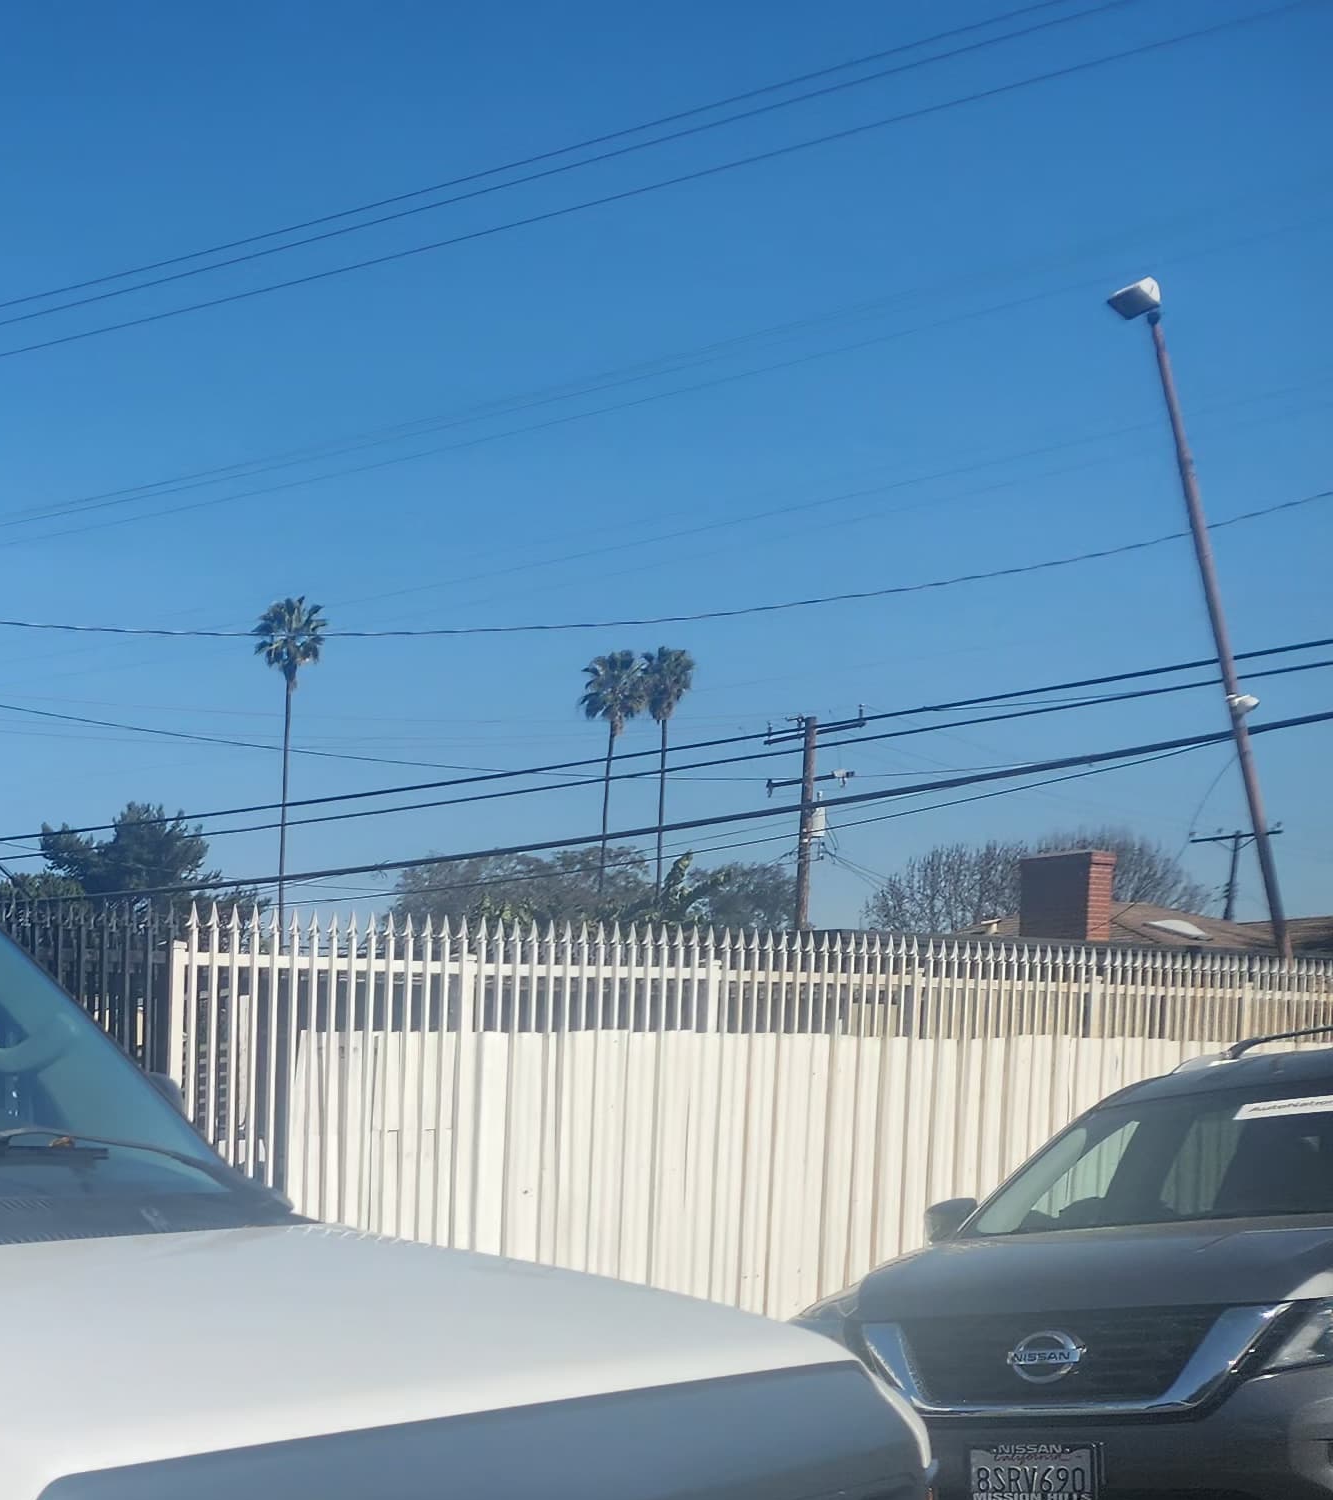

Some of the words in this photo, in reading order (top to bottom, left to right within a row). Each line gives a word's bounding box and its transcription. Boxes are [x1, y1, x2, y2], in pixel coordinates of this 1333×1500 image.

[1014, 1351, 1071, 1362] NISSAN
[997, 1444, 1063, 1454] NISSAN
[977, 1465, 1086, 1493] 8SRV690
